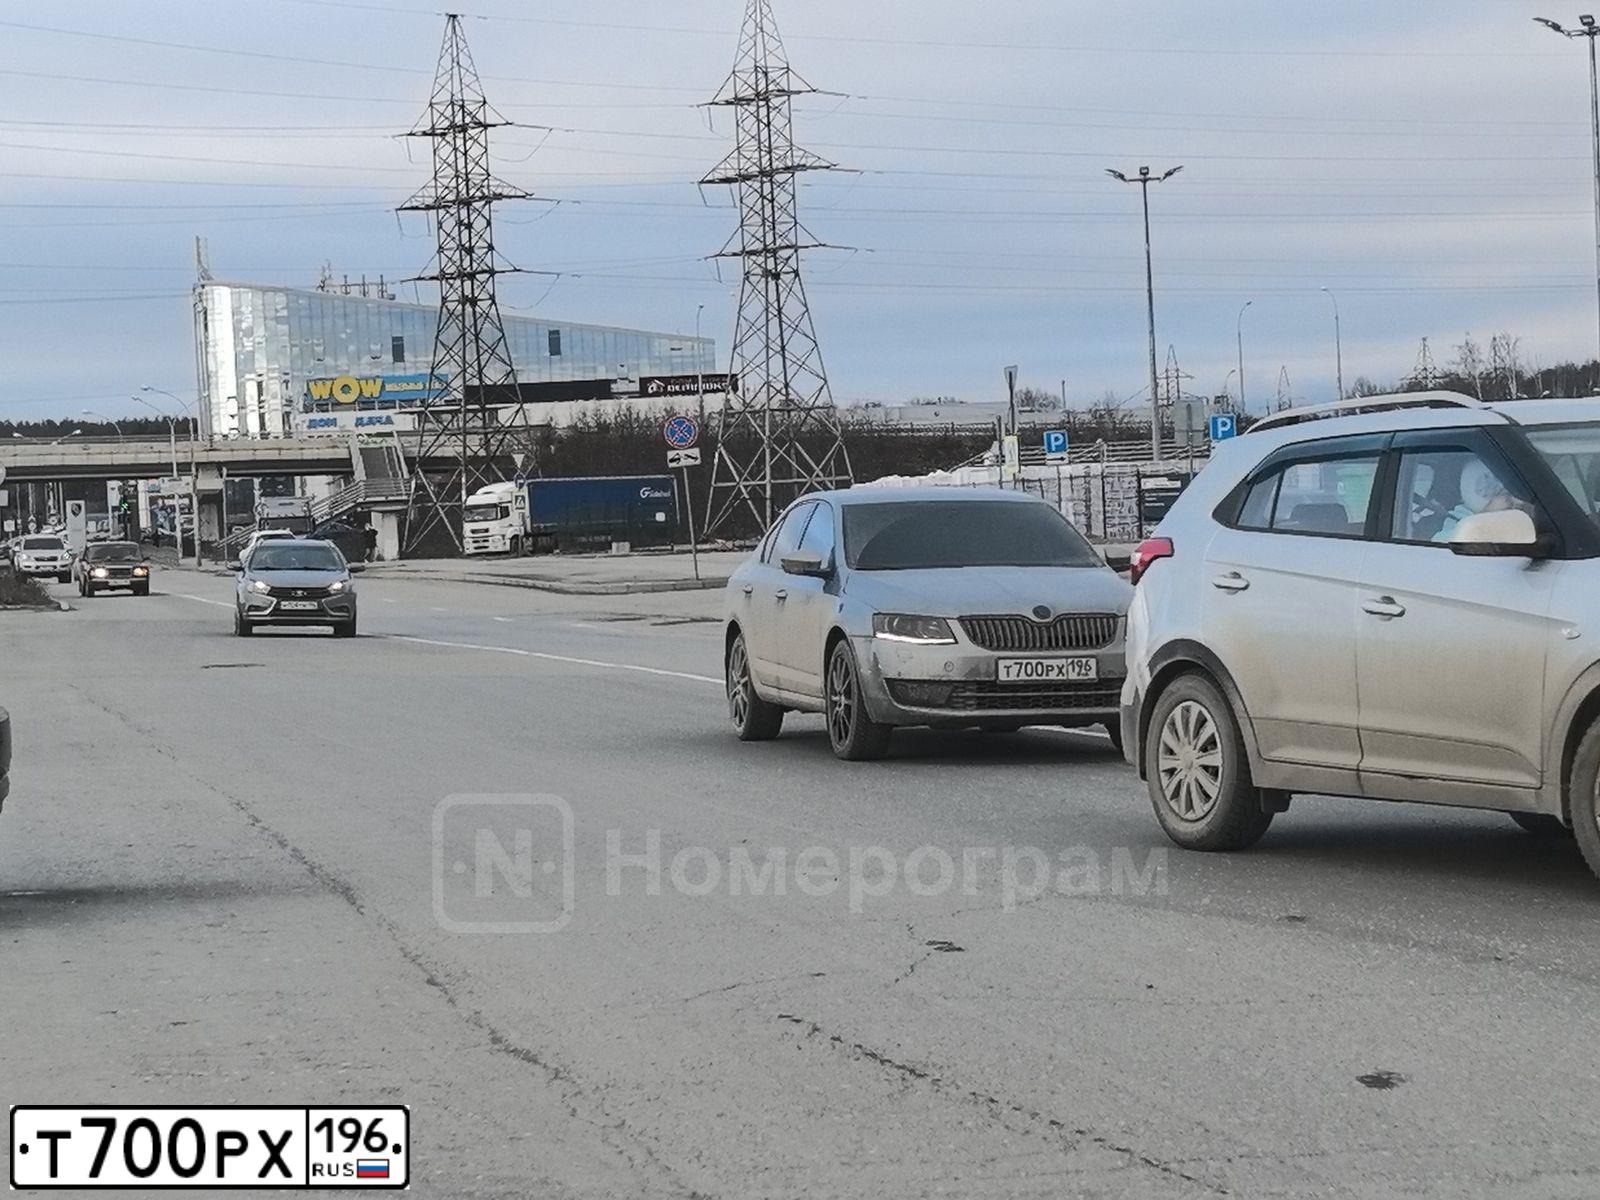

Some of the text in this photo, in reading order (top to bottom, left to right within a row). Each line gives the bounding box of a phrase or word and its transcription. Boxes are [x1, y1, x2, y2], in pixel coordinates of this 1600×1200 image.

[308, 375, 383, 403] WOW
[1218, 417, 1231, 438] P
[1051, 433, 1064, 451] P
[1003, 660, 1092, 678] Т700РХ 196
